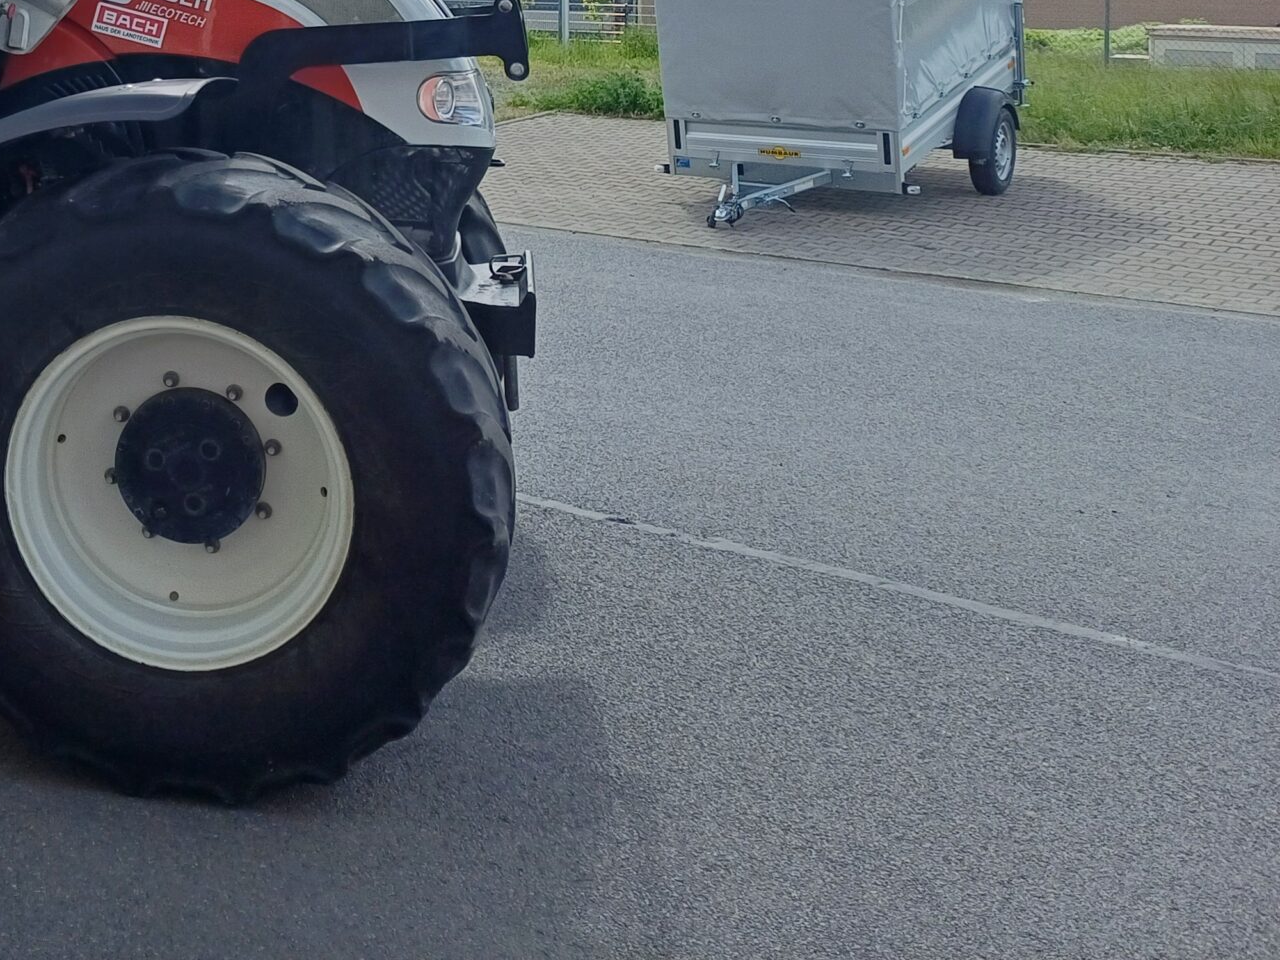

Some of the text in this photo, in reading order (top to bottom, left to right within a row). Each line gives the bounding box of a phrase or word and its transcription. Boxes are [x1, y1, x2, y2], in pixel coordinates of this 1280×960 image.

[102, 9, 159, 35] BACH
[149, 3, 207, 28] ECOTECH
[93, 24, 160, 45] HAUS DER LANDTECHNIK
